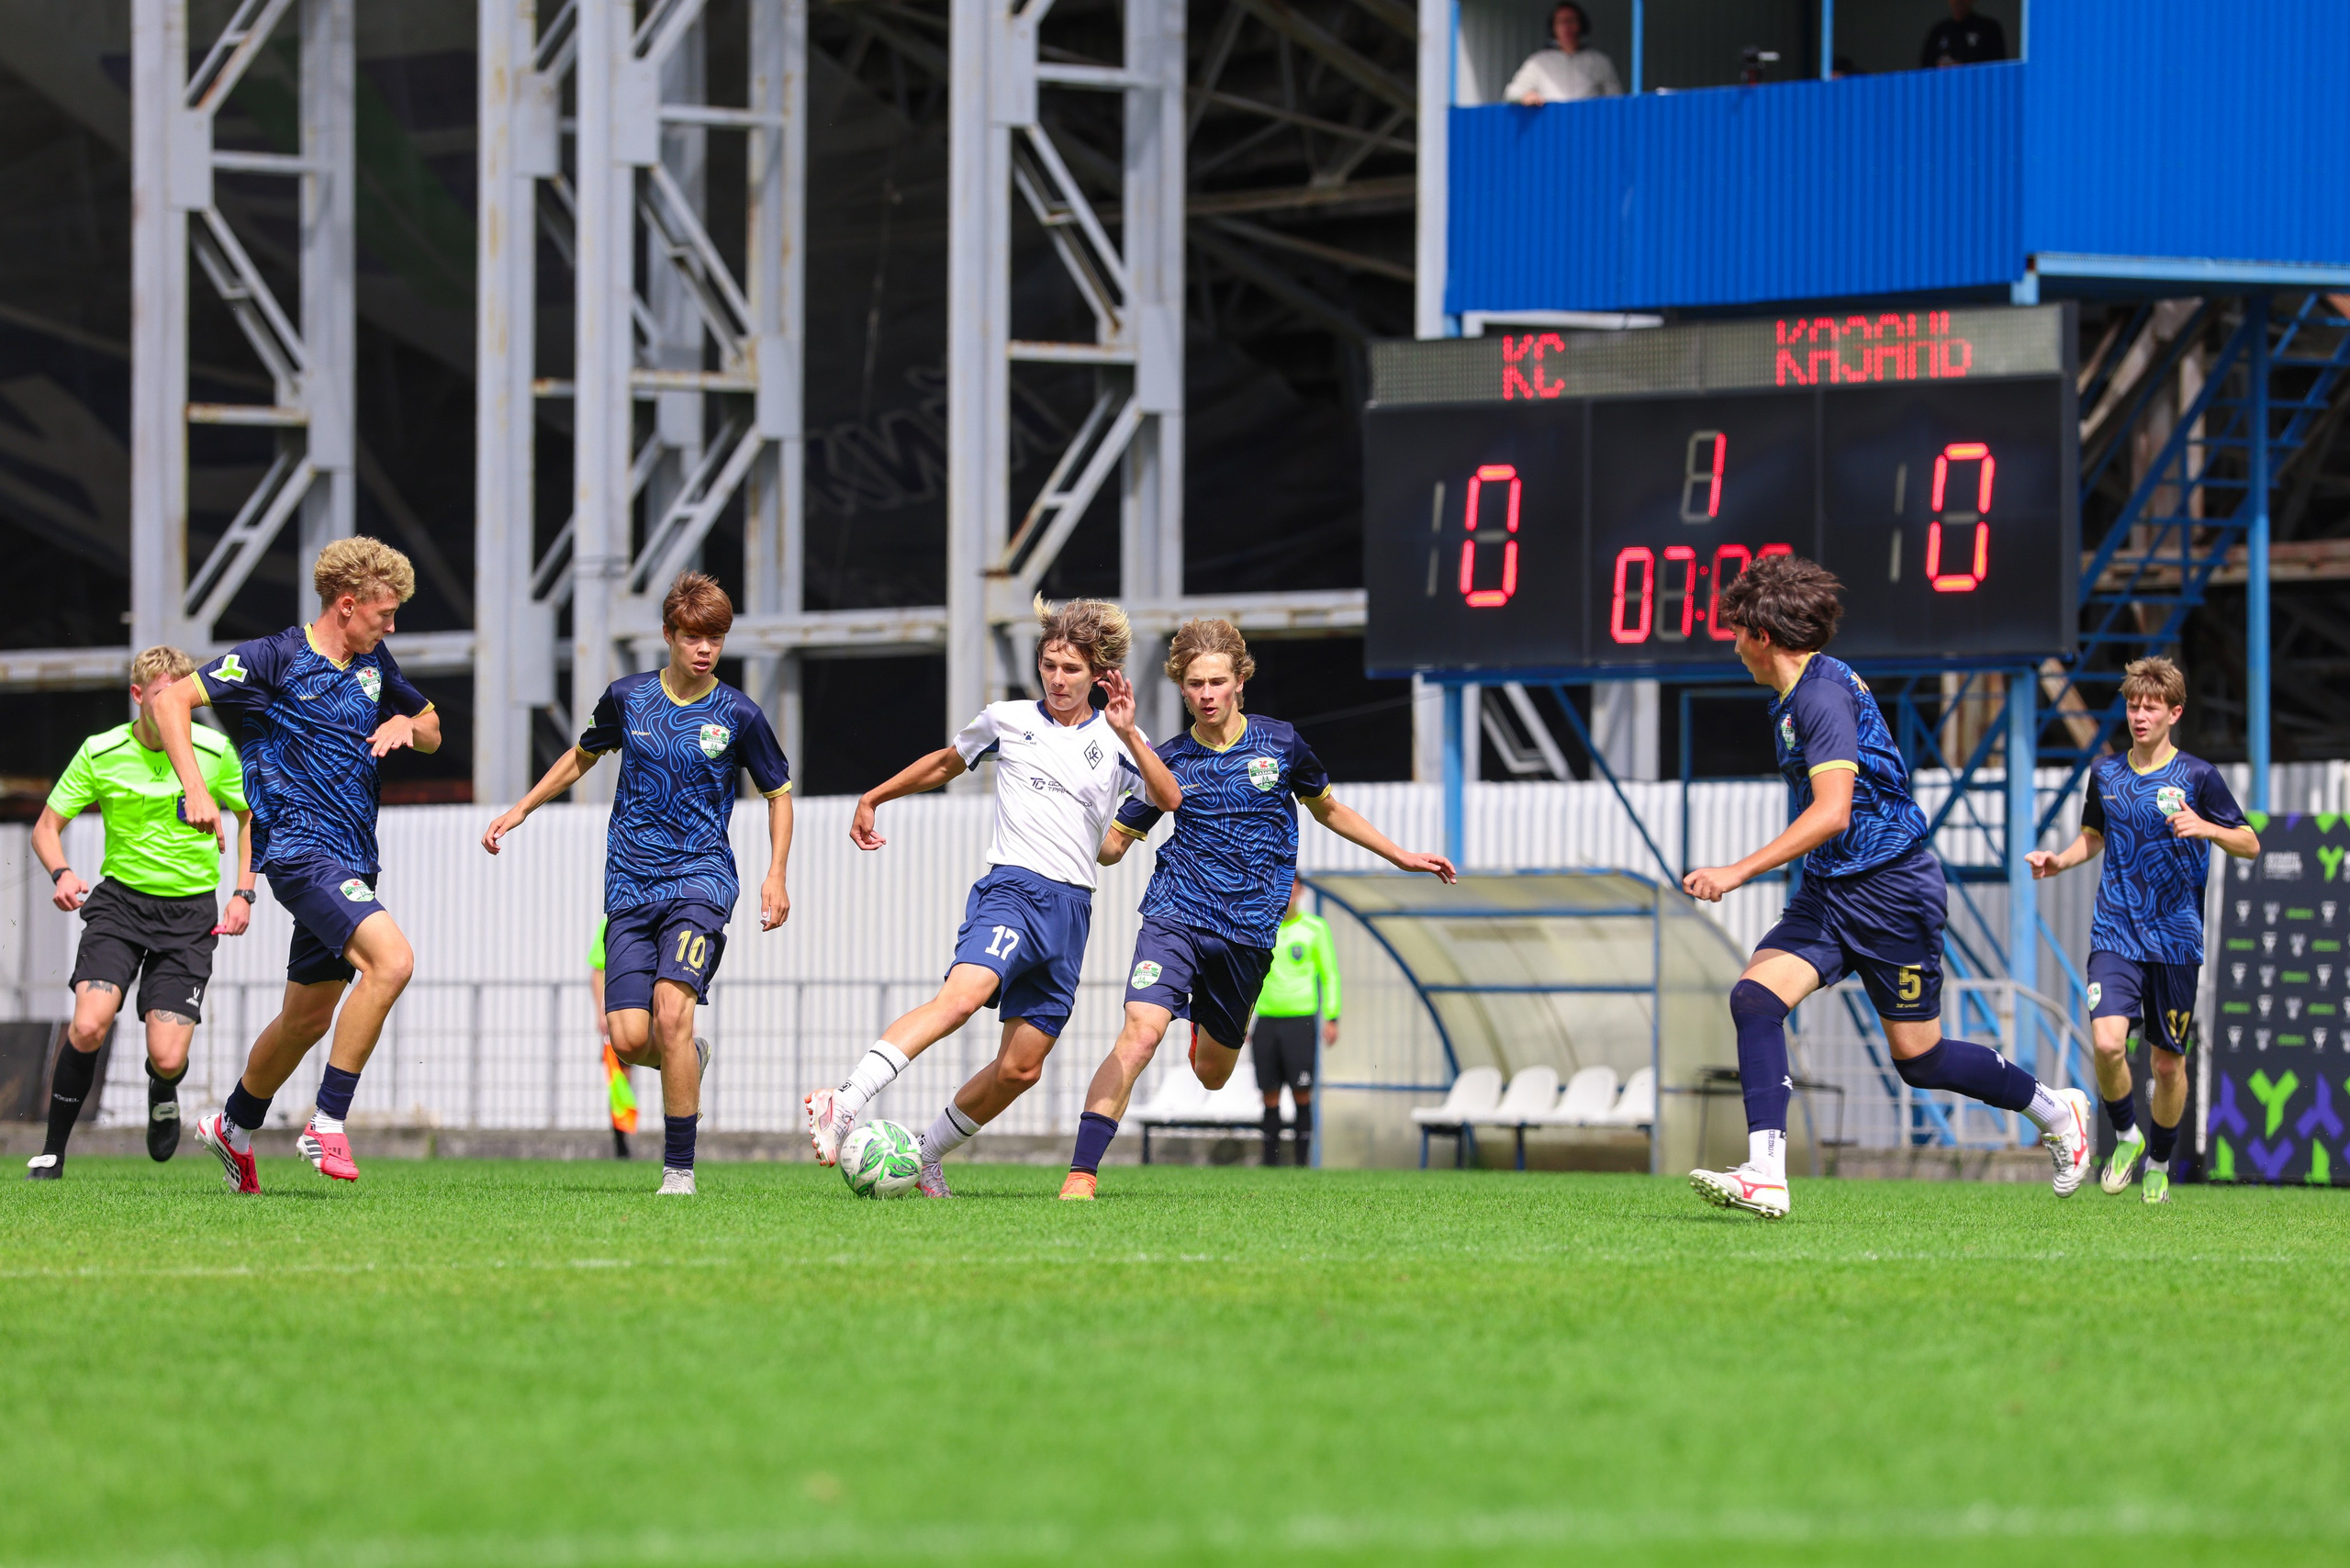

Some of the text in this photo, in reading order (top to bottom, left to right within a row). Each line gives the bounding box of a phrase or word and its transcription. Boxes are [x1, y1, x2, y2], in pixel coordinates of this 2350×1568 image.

[1503, 332, 1565, 401] КС
[1775, 310, 1973, 386] КАЗАНЬ
[1708, 432, 1728, 518] 1
[1460, 465, 1522, 608] 0
[1926, 442, 1996, 592] 0
[1610, 543, 1794, 644] 07:0
[676, 930, 706, 969] 10
[984, 924, 1020, 961] 17
[1898, 964, 1922, 1002] 5
